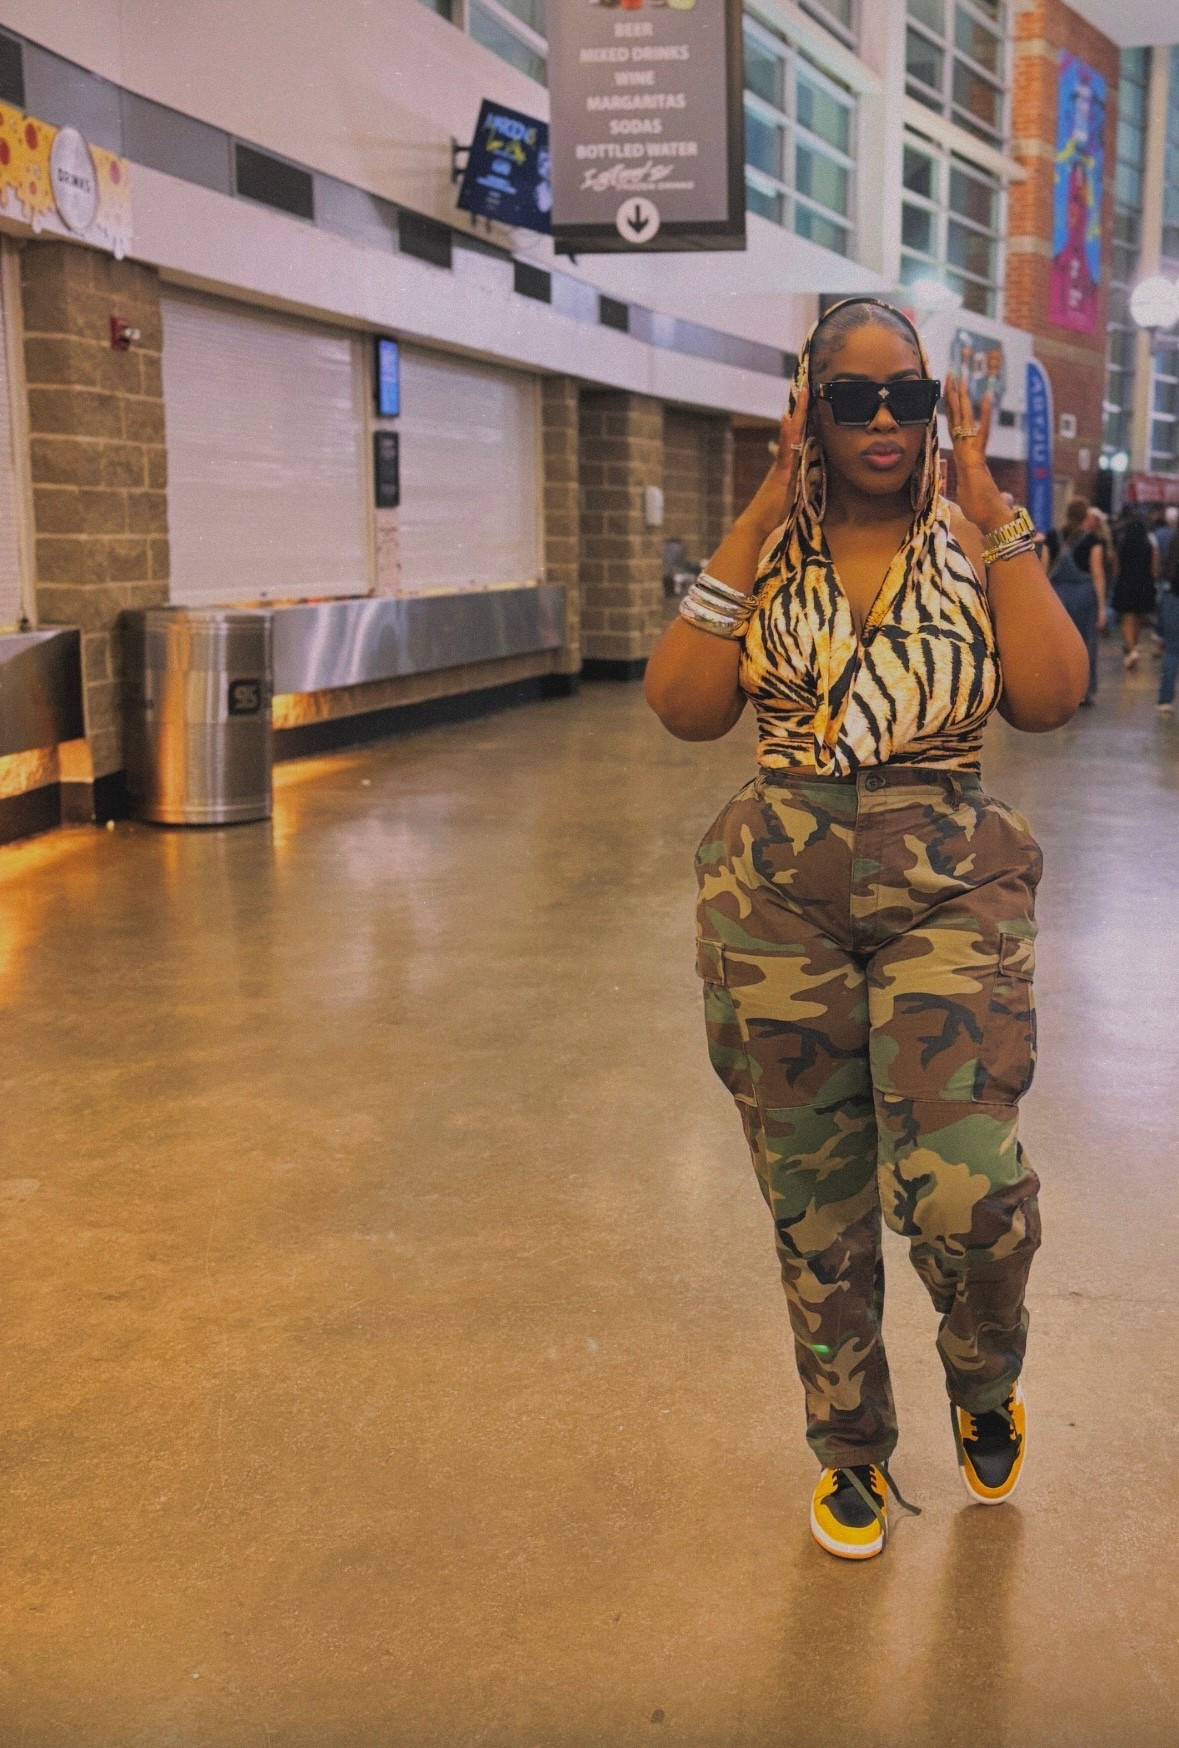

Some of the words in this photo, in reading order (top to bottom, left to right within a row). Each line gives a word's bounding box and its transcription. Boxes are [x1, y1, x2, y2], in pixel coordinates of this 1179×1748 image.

[614, 22, 653, 38] BEER
[579, 47, 629, 63] MIXED
[631, 45, 690, 62] DRINKS
[614, 70, 655, 86] WINE
[586, 93, 686, 111] MARGARITAS
[609, 118, 663, 135] SODAS
[575, 143, 645, 160] BOTTLED
[646, 141, 698, 157] WATER
